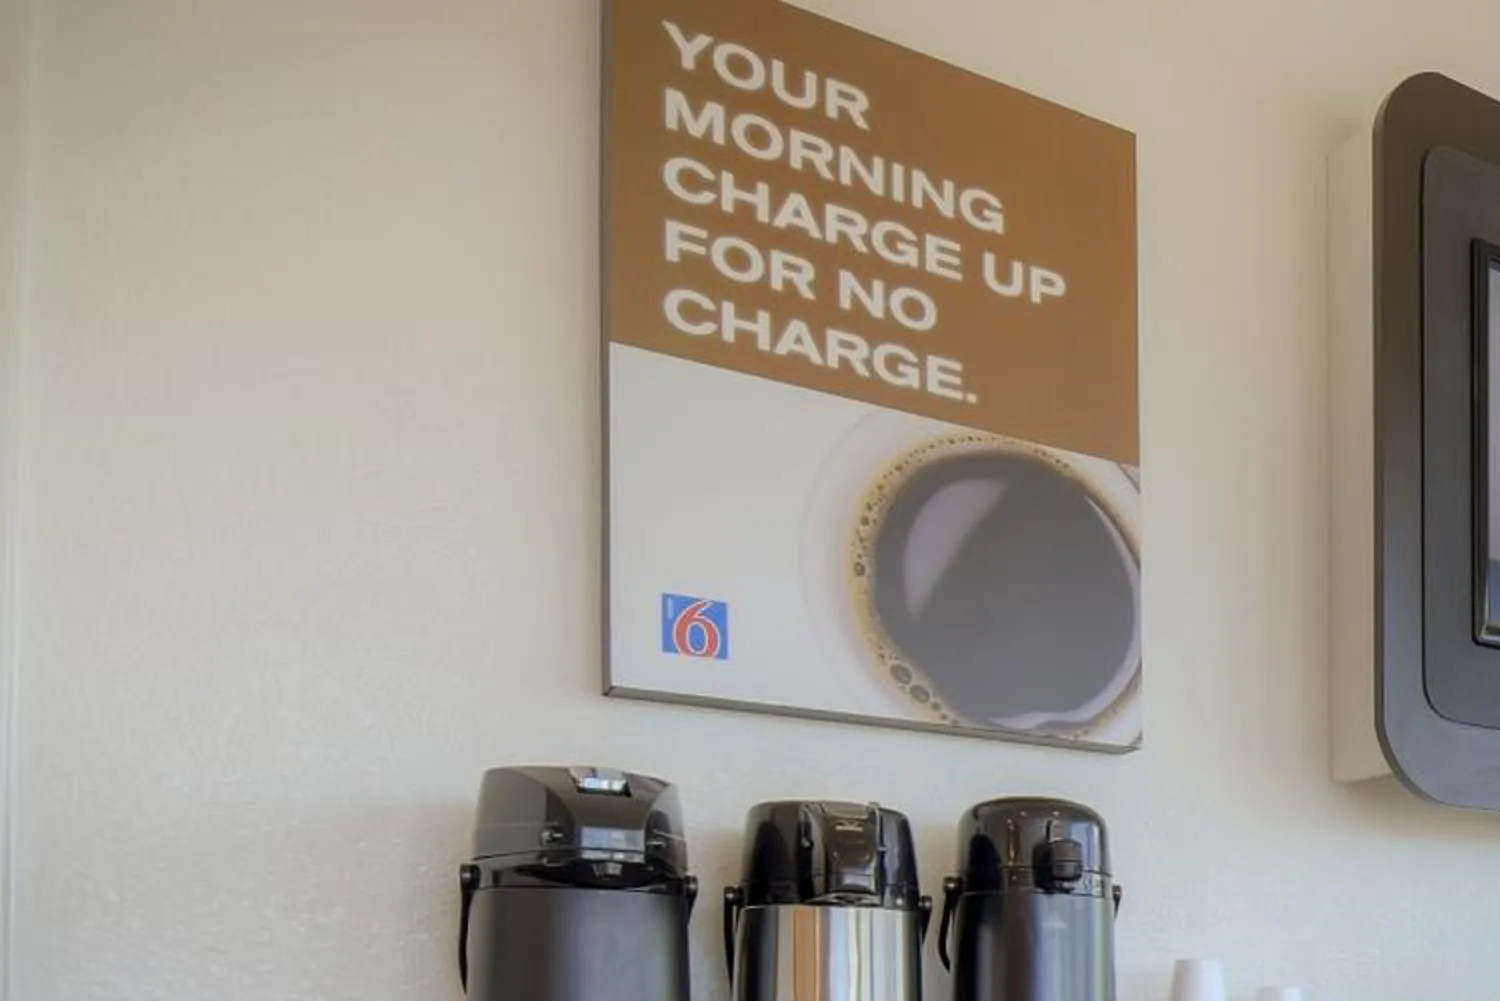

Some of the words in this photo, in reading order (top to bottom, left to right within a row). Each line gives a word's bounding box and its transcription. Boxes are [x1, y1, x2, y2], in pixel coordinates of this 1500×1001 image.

[662, 20, 870, 130] YOUR
[664, 88, 1005, 235] MORNING
[663, 156, 963, 281] CHARGE
[982, 252, 1067, 304] UP
[664, 220, 816, 300] FOR
[839, 270, 938, 332] NO
[663, 289, 977, 404] CHARGE.
[672, 599, 720, 658] 6
